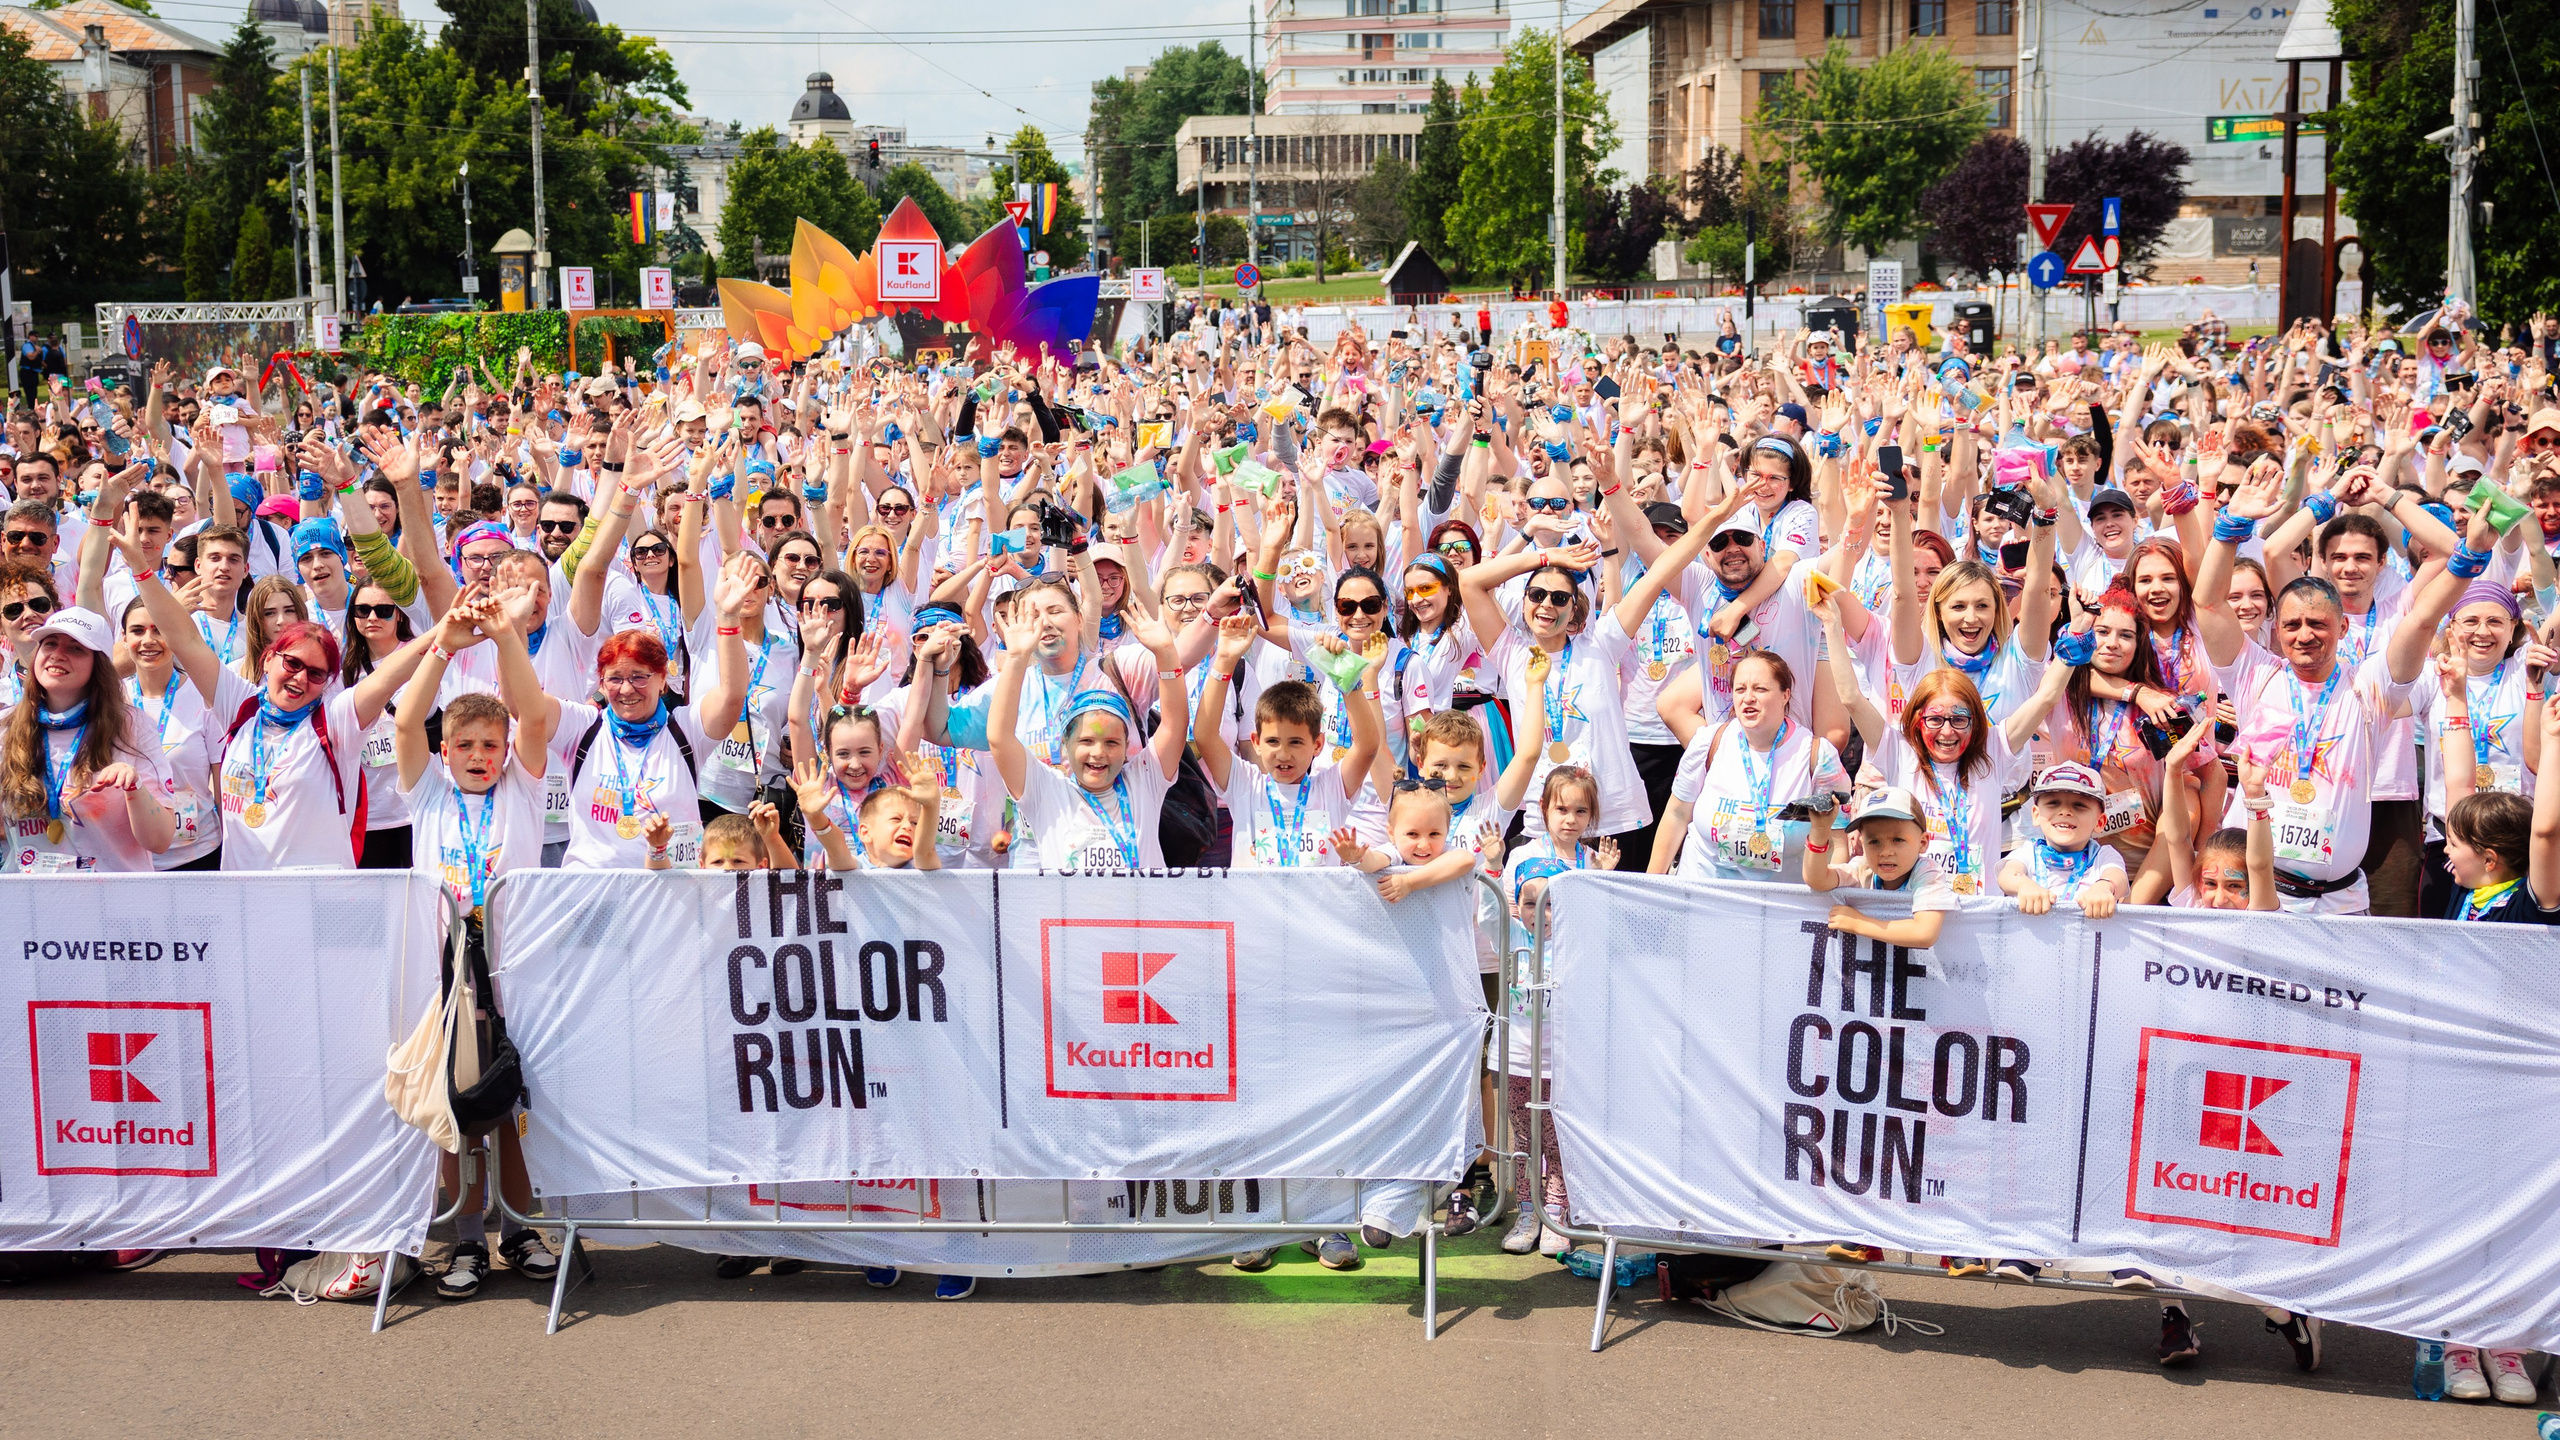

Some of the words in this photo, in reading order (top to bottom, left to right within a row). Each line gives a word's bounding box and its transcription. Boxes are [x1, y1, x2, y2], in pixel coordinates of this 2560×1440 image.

[887, 281, 931, 289] Kaufland
[55, 617, 93, 631] ARCADIS
[1662, 637, 1681, 653] 522
[1891, 699, 1907, 714] RU
[1027, 728, 1049, 745] THE
[366, 737, 392, 757] 17345
[721, 738, 751, 760] 16347
[225, 759, 250, 779] THE
[2267, 767, 2292, 789] RUN
[222, 775, 255, 798] COLO
[600, 773, 621, 789] THE
[222, 793, 244, 814] RUN
[546, 792, 570, 810] 8124
[592, 787, 624, 807] COL
[1718, 797, 1739, 814] THE
[591, 804, 619, 824] RUN
[1920, 801, 1936, 817] THE
[18, 818, 48, 838] RUN
[937, 816, 957, 835] 846
[2105, 811, 2131, 833] 8309
[2280, 824, 2319, 848] 15734
[440, 846, 462, 866] THE
[675, 842, 696, 862] 18125
[1083, 847, 1122, 867] 15935
[727, 869, 848, 939] THE
[24, 940, 163, 961] POWERED
[173, 942, 209, 962] BY
[1800, 920, 1930, 1021] THE
[728, 940, 948, 1026] COLOR
[2144, 961, 2312, 1003] POWERED
[2324, 987, 2368, 1011] BY
[1066, 1041, 1214, 1068] Kaufland
[733, 1027, 867, 1112] RUN
[869, 1082, 888, 1098] TM
[1786, 1013, 2031, 1124] COLOR
[56, 1119, 194, 1146] Kaufland
[1784, 1102, 1927, 1204] RUN
[1926, 1179, 1945, 1197] TM
[2153, 1161, 2320, 1210] Kaufland
